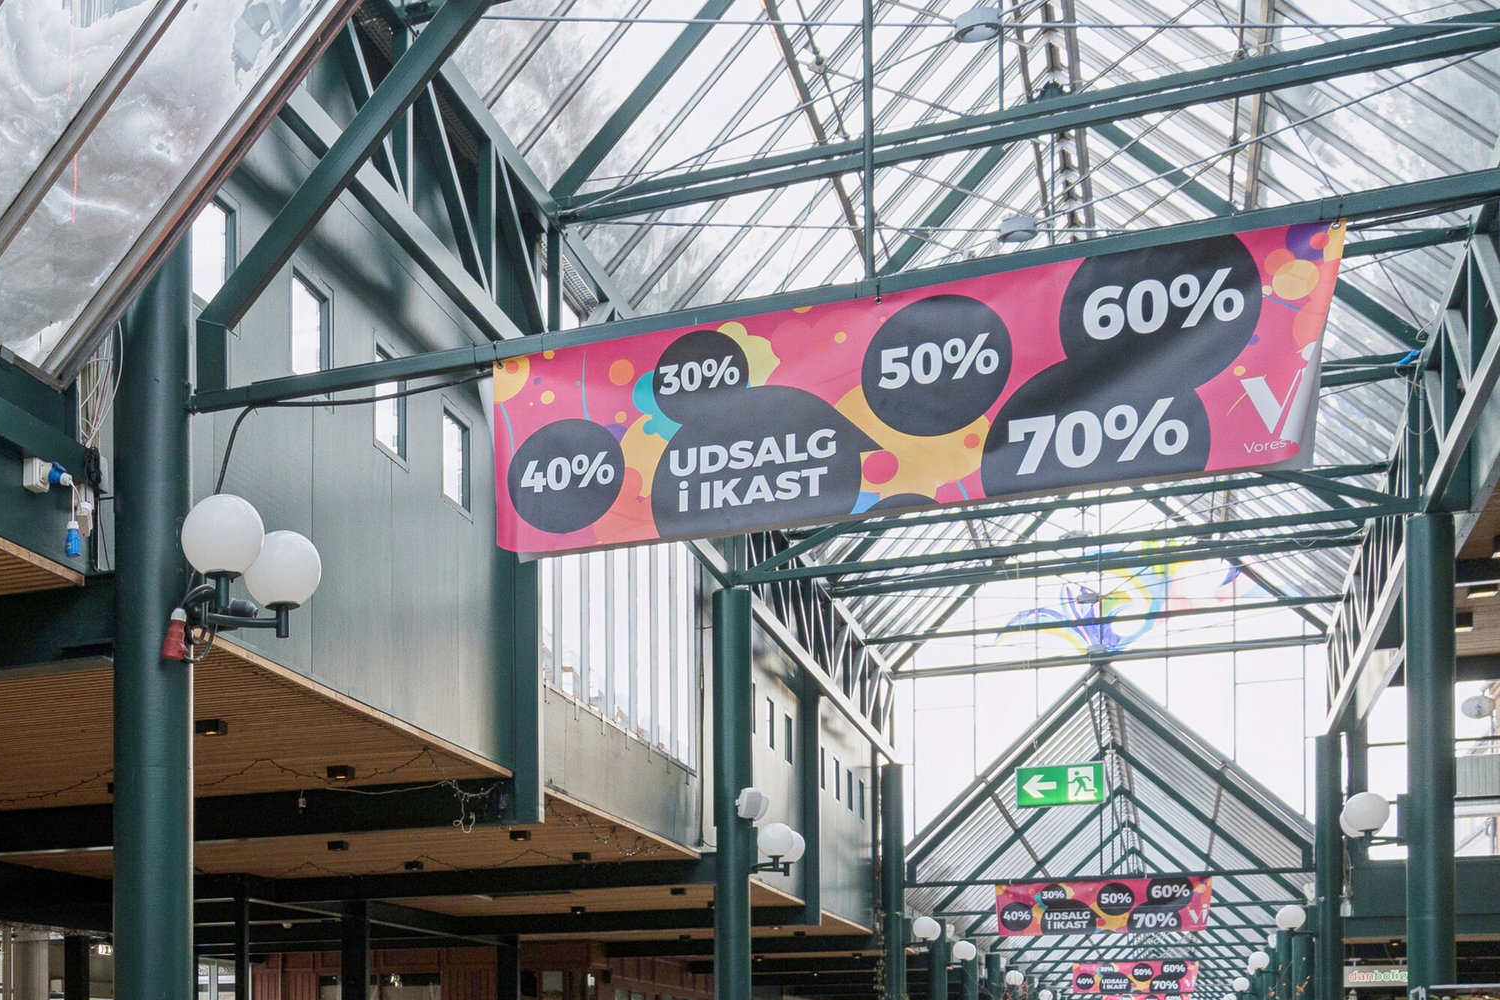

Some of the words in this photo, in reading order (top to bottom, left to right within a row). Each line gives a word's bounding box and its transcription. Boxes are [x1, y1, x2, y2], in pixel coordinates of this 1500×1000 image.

[1082, 268, 1245, 341] 60%
[879, 334, 1000, 391] 50%
[658, 355, 741, 396] 30%
[1008, 397, 1190, 475] 70%
[668, 428, 838, 479] UDSALG
[1243, 440, 1287, 454] Vores
[520, 450, 615, 494] 40%
[678, 474, 691, 513] i
[698, 468, 831, 510] IKAST
[1042, 890, 1065, 899] 30%
[1101, 893, 1132, 904] 50%
[1151, 885, 1190, 898] 60%
[1003, 911, 1031, 921] 40%
[1044, 911, 1091, 921] UDSALG
[1133, 913, 1178, 928] 70%
[1053, 921, 1089, 929] IKAST
[1163, 964, 1186, 973] 60%
[1152, 980, 1178, 989] 70%
